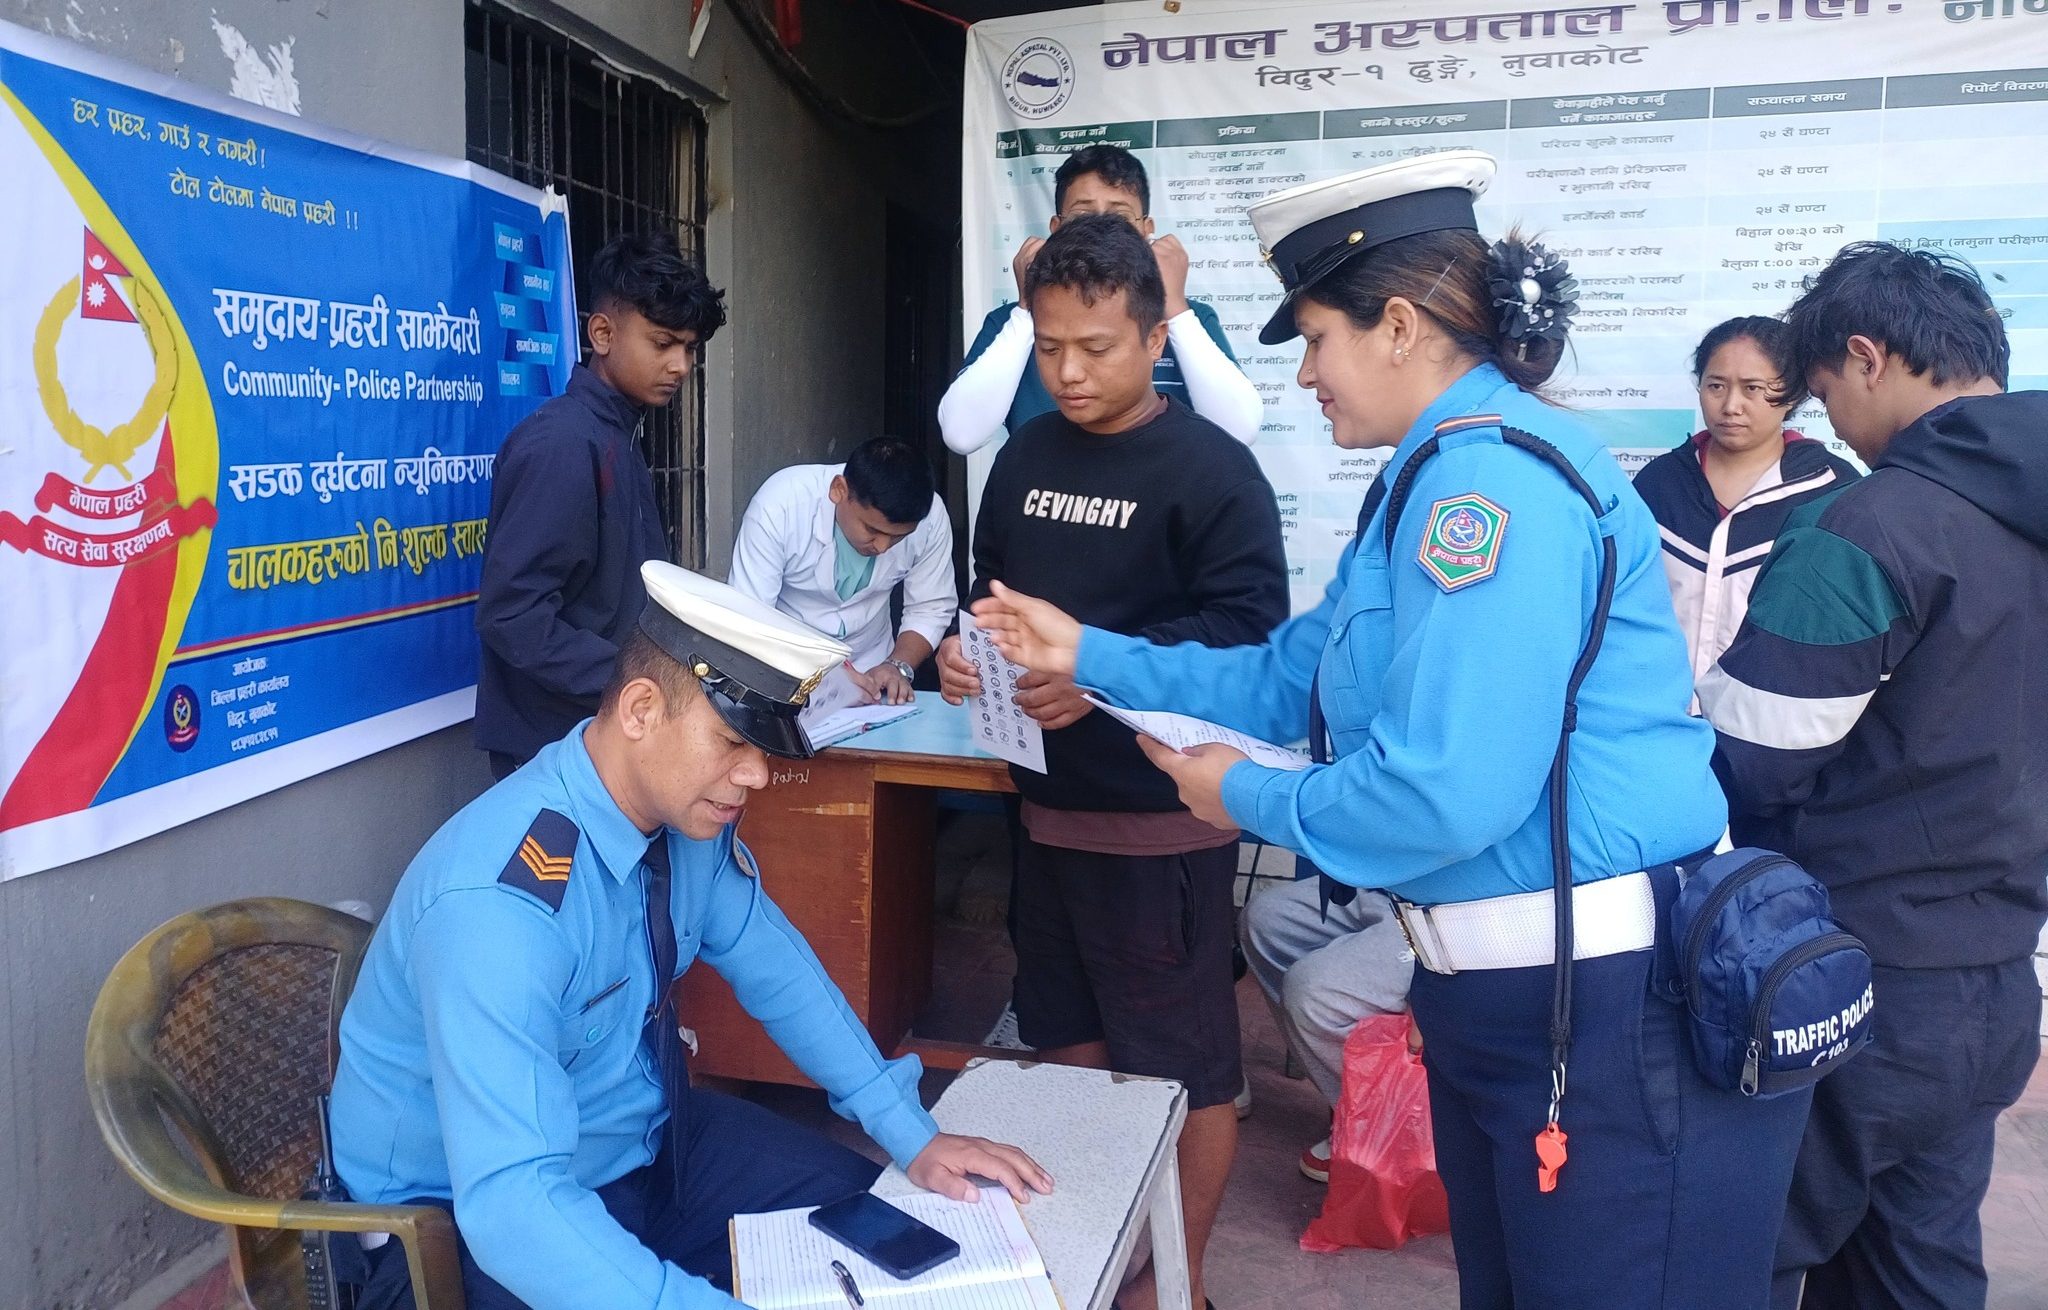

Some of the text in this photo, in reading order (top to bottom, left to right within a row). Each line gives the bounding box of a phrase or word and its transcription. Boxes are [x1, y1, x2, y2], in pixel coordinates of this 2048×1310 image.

[1101, 29, 1288, 70] नेपाल
[1314, 4, 1637, 54] अस्पताल
[1255, 62, 1384, 91] विदुर-१
[1501, 45, 1649, 78] नुवाकोट
[1961, 81, 2001, 93] रिपोर्ट
[1811, 92, 1847, 102] समय
[71, 98, 100, 128] हर
[107, 107, 151, 141] प्रहर,
[197, 132, 212, 156] र
[1218, 126, 1256, 138] प्रक्रिया
[1799, 127, 1831, 137] घण्टा
[1622, 134, 1674, 145] कागजात
[1590, 166, 1619, 176] लागि
[1797, 165, 1829, 175] घण्टा
[169, 167, 200, 199] टोल
[207, 175, 255, 209] टोलमा
[260, 186, 297, 218] नेपाल
[303, 199, 336, 226] प्रहरी
[1620, 209, 1647, 220] कार्ड
[1795, 204, 1826, 213] घण्टा
[1823, 224, 1844, 234] बजे
[1775, 241, 1803, 252] देखि
[1948, 237, 1994, 248] (नमुना
[1588, 247, 1615, 257] कार्ड
[1721, 259, 1759, 271] बेलुका
[1799, 257, 1821, 266] बजे
[212, 288, 481, 356] समुदाय-प्रहरी साझेदारी
[223, 361, 484, 408] Community- Police Partnership
[228, 463, 303, 502] सडक
[310, 451, 387, 503] दुर्घटना
[69, 482, 147, 515] नेपाल प्रहरी
[1024, 489, 1137, 529] CEVINGHY
[43, 518, 174, 562] सत्य सेवा सुरक्षणम्
[1773, 982, 1874, 1055] TRAFFIC POLICE
